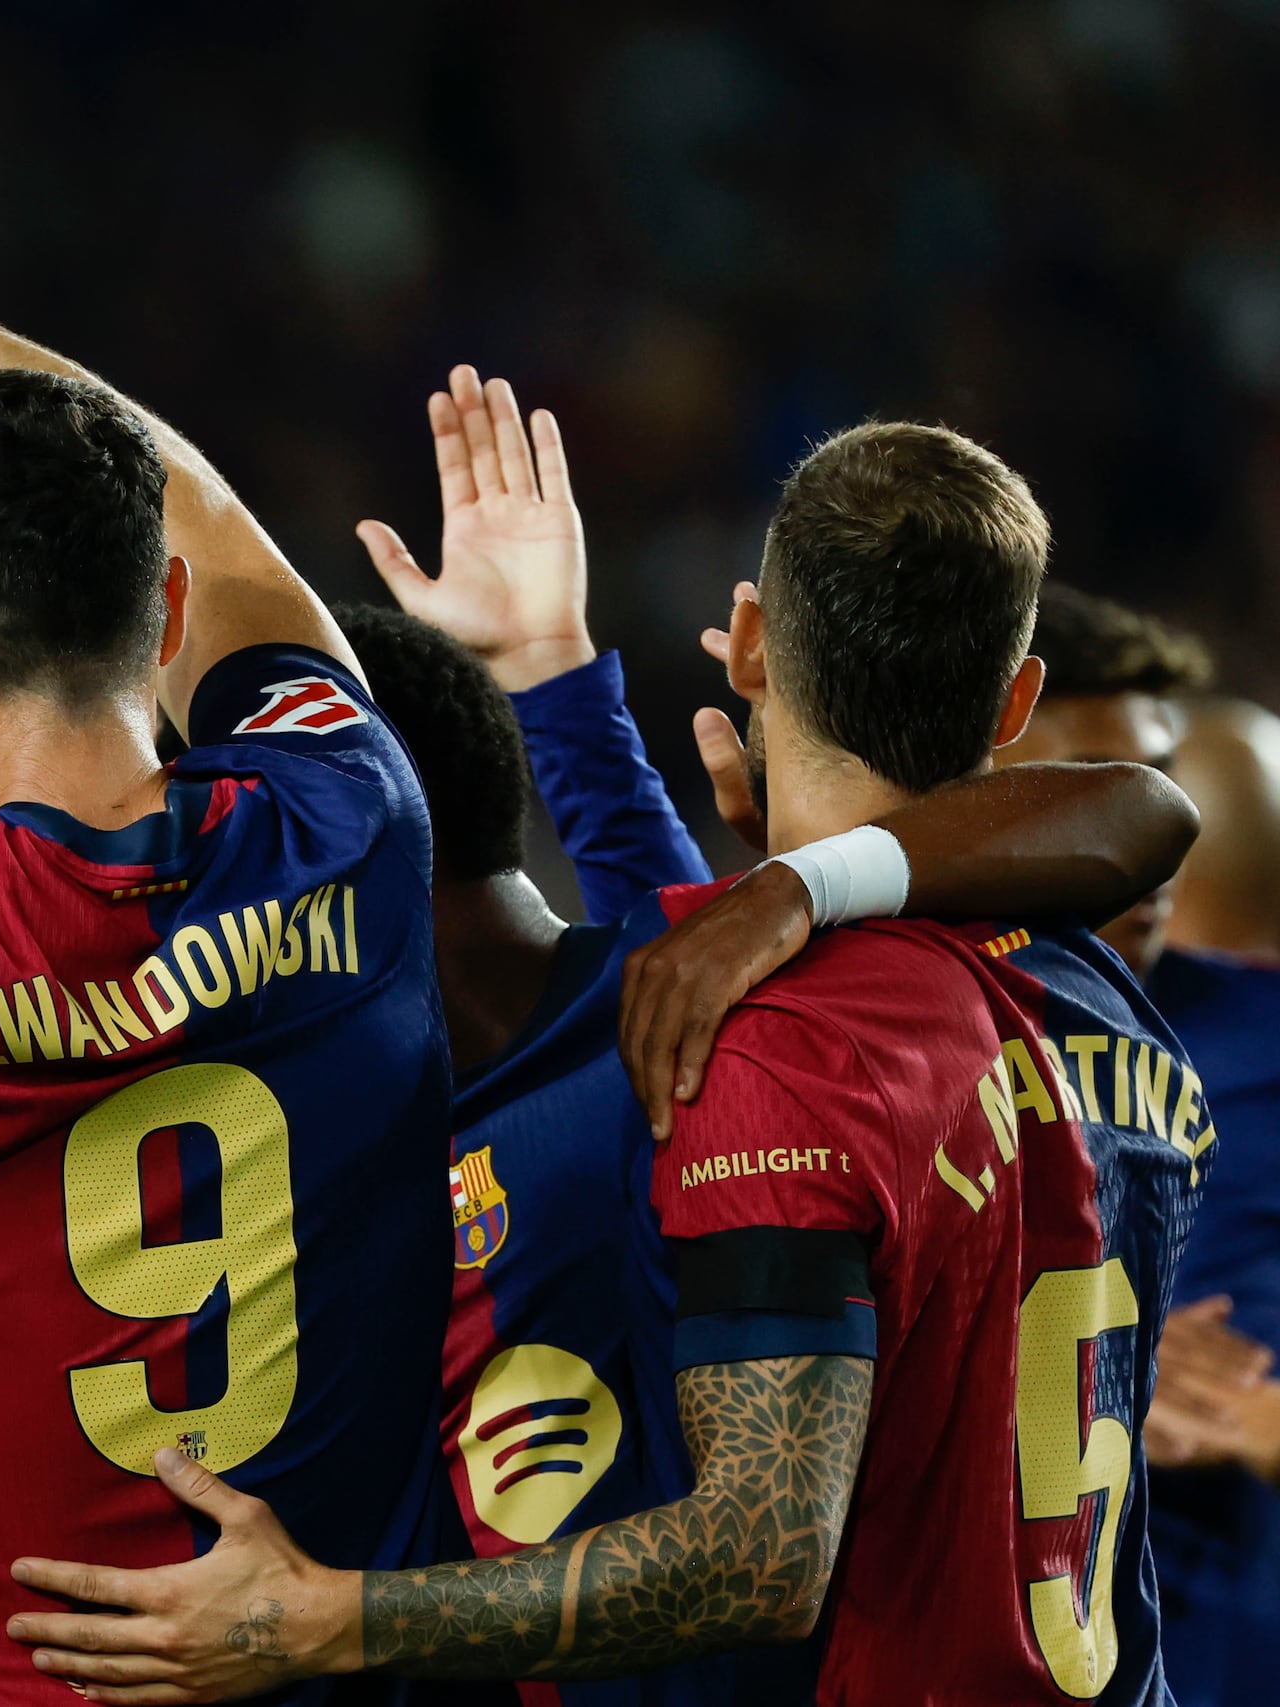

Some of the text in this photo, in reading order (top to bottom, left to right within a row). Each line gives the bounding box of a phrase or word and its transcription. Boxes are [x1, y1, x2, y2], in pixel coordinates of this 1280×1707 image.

[64, 1062, 298, 1478] 9
[681, 1148, 832, 1192] AMBILIGHT
[934, 1142, 996, 1214] I.
[1016, 1257, 1140, 1700] 5
